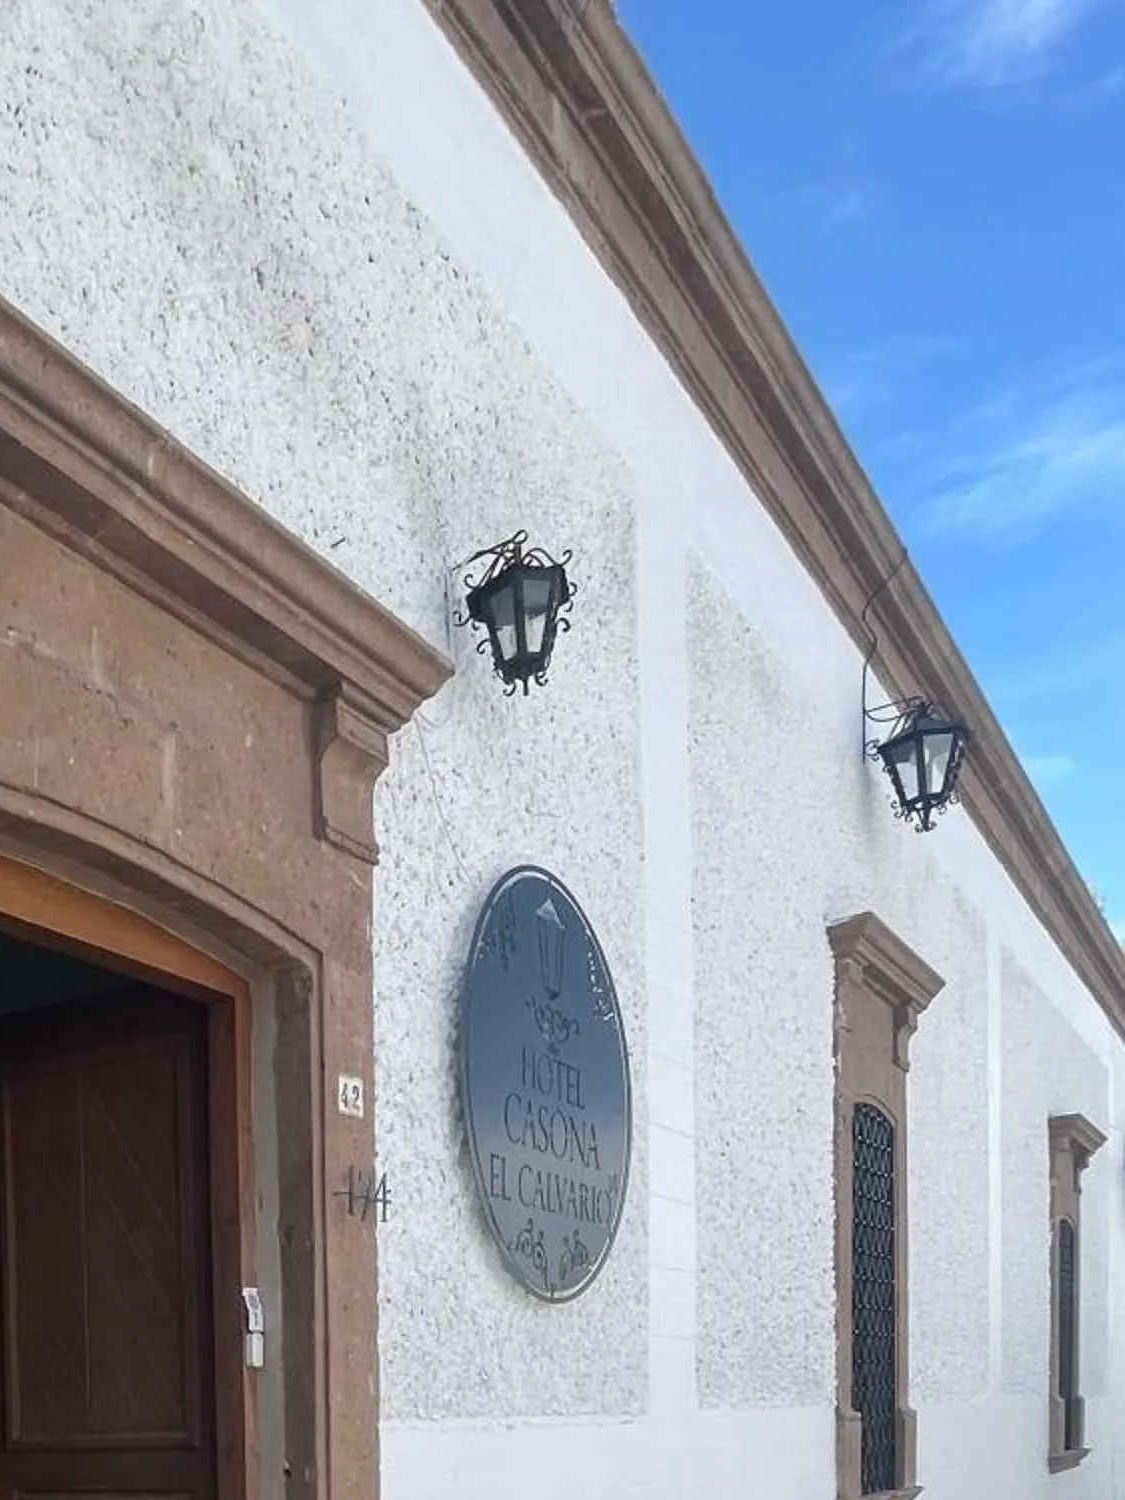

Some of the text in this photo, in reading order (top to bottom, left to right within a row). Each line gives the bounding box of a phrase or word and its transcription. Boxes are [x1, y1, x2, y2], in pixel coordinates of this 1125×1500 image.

[340, 1082, 361, 1110] 42
[521, 1045, 585, 1110] HOTEL
[504, 1091, 601, 1171] CASONA
[489, 1152, 613, 1226] EL CALVARIO
